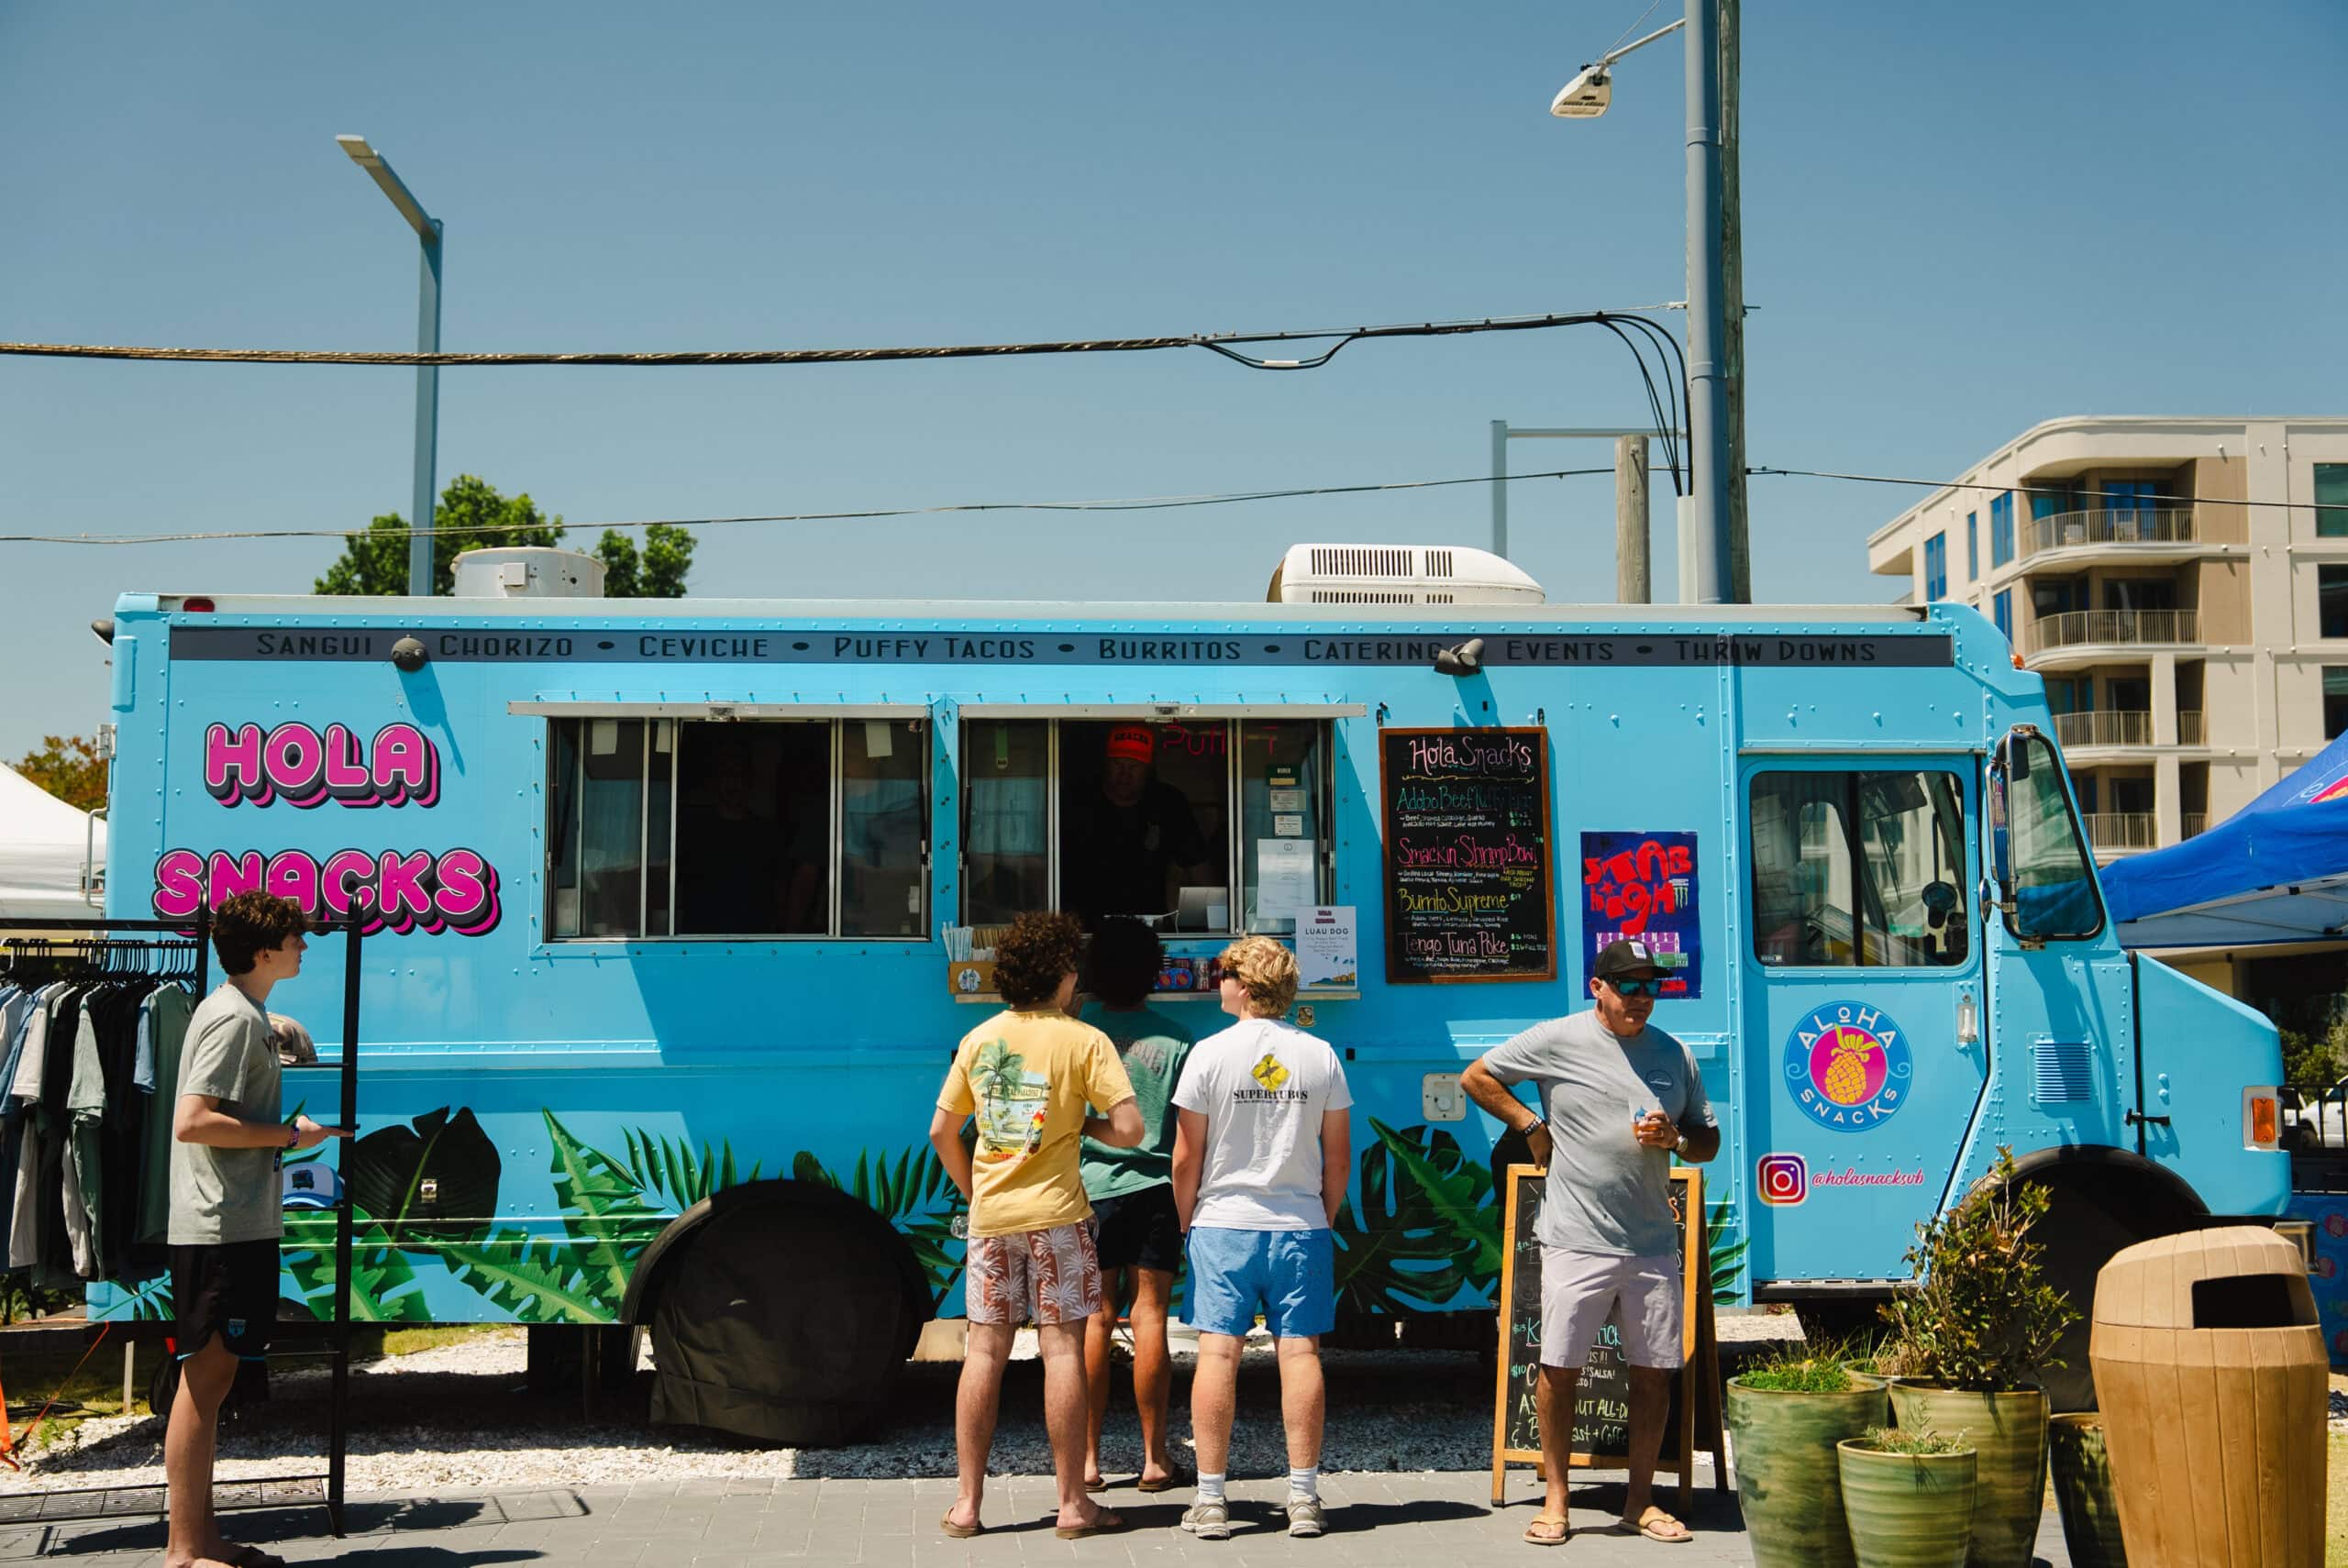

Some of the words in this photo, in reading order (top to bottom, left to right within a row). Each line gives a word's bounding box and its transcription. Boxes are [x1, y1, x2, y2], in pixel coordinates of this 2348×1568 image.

[256, 634, 371, 656] SANGUI
[438, 635, 573, 657] CHORIZO
[638, 635, 769, 658] CEVICHE
[834, 636, 928, 659] PUFFY
[945, 637, 1035, 659] TACOS
[1100, 638, 1241, 660] BURRITOS
[1304, 639, 1443, 660] CATERING
[1507, 640, 1614, 661] EVENTS
[1778, 640, 1876, 662] DOWNS
[204, 721, 441, 809] HOLA
[1409, 735, 1458, 776] Hola
[1460, 734, 1533, 774] Snacks
[1396, 787, 1438, 812] Adobo
[1439, 785, 1475, 811] Beef
[152, 848, 503, 936] SNACKS
[1398, 887, 1446, 911] Burrito
[1447, 886, 1510, 918] Supreme
[1305, 927, 1327, 935] LUAU
[1330, 927, 1349, 935] DOG
[1398, 931, 1442, 960] Tengo
[1440, 931, 1476, 955] Tuna
[1477, 931, 1511, 955] Poke
[1799, 1007, 1896, 1049] ALOHA
[1800, 1088, 1898, 1123] SNACKS
[1811, 1167, 1925, 1187] @holasnacksvb
